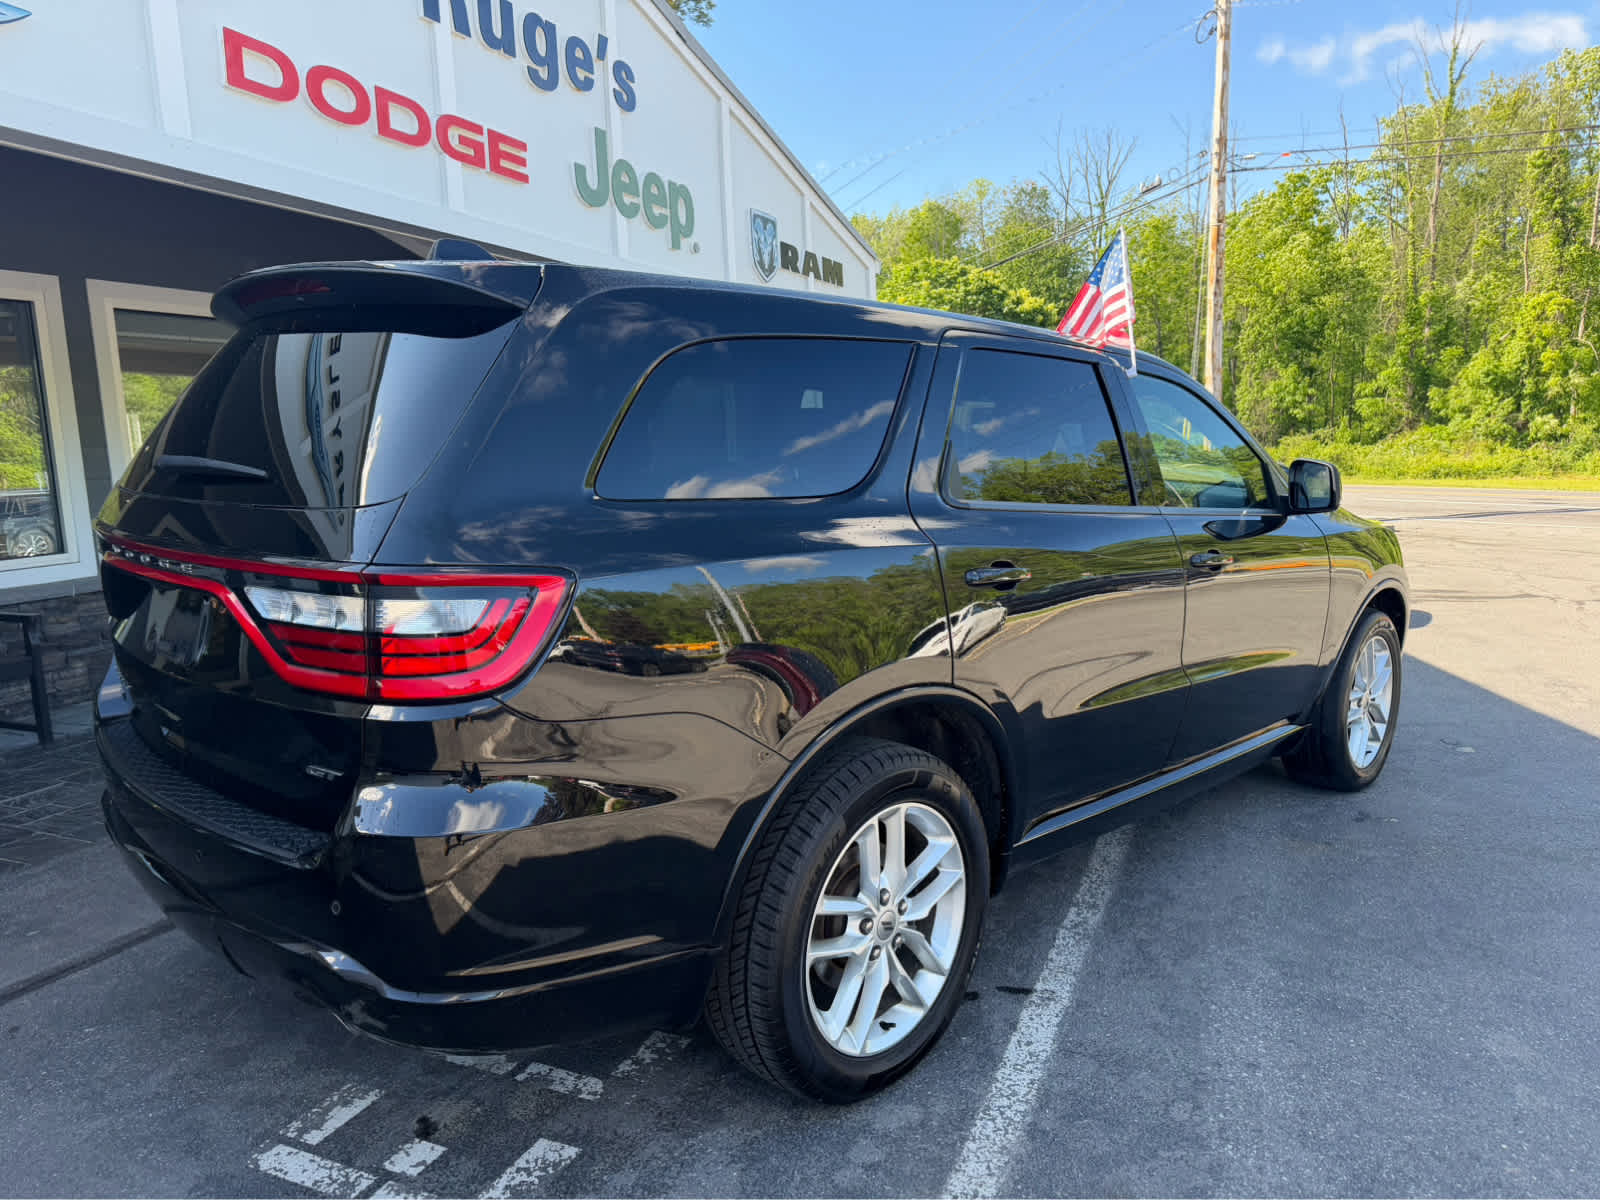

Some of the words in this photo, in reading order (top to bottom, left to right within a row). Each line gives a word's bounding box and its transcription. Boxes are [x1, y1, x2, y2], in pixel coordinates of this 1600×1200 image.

[222, 26, 530, 185] DODGE
[574, 126, 696, 250] Jeep
[779, 241, 844, 288] RAM
